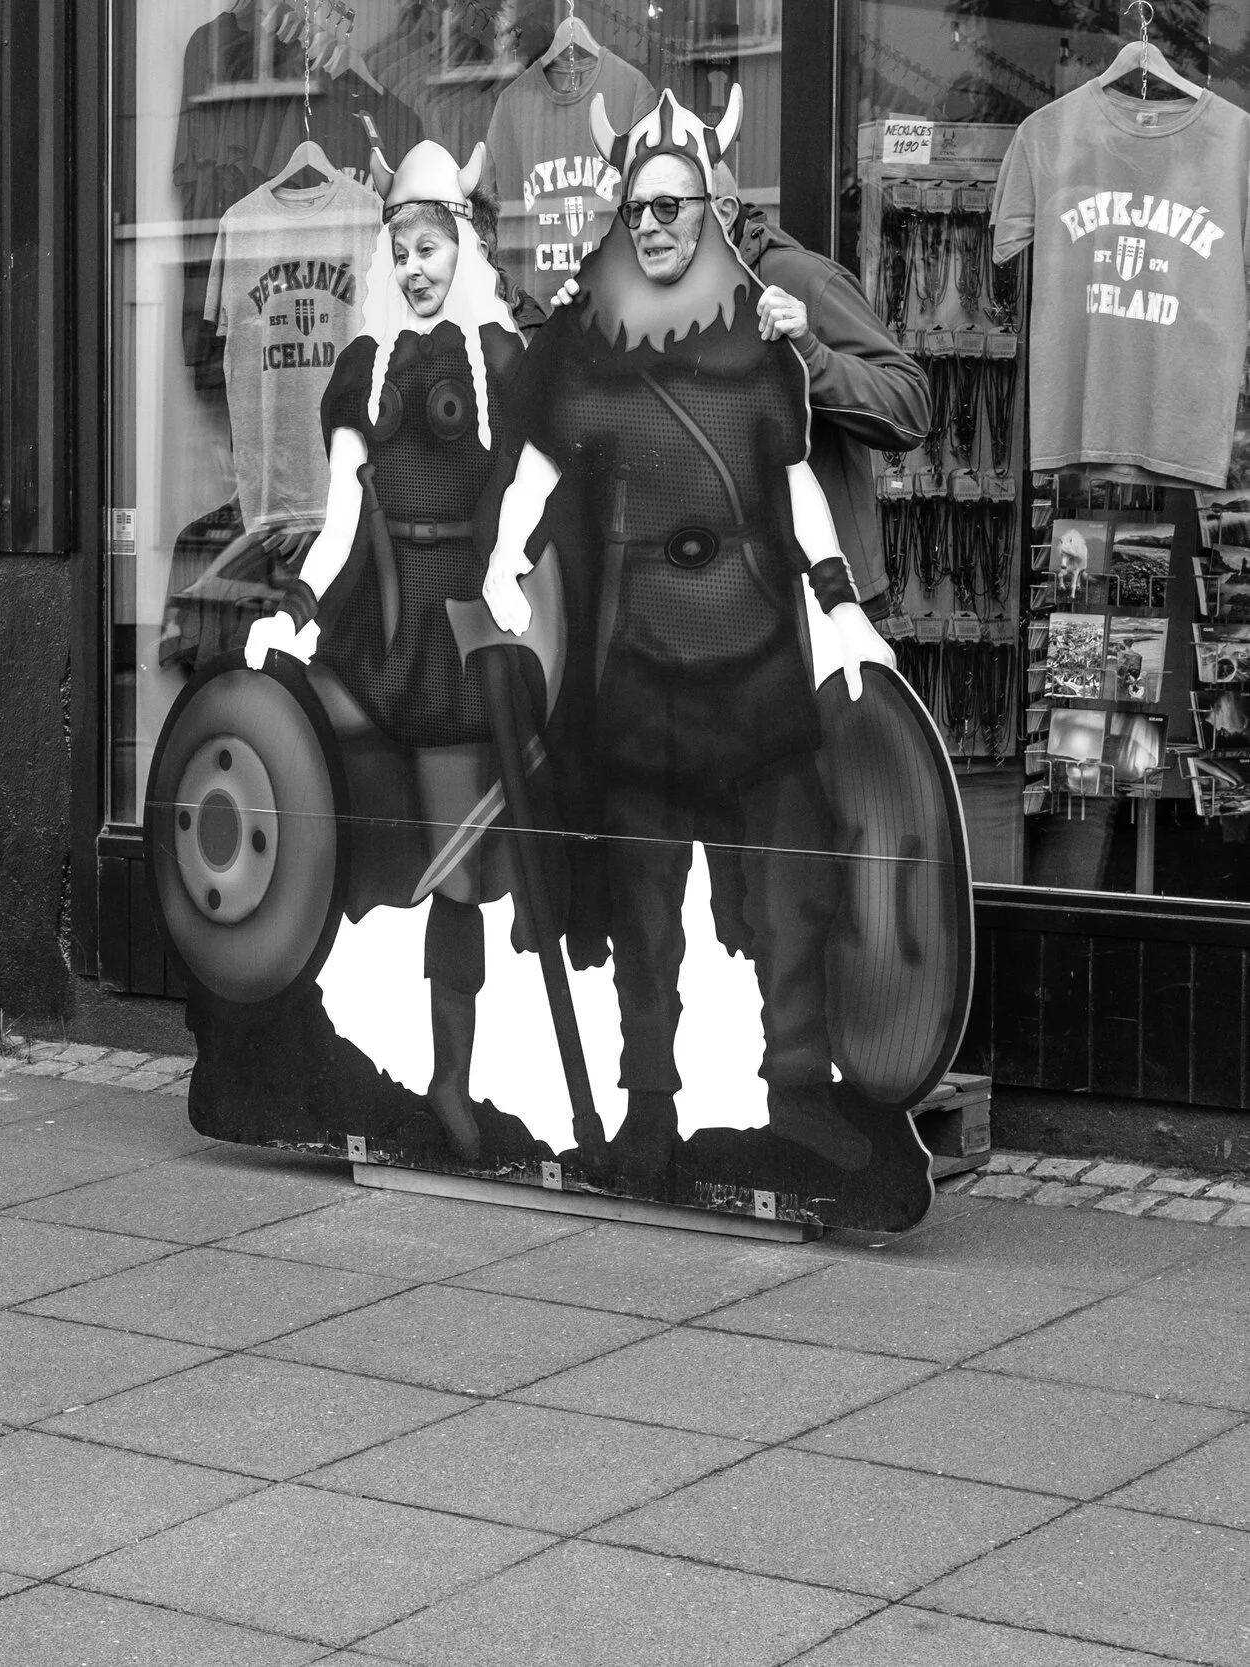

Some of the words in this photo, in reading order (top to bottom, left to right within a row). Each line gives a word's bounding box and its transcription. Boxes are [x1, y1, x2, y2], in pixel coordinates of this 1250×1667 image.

[885, 124, 933, 136] NECKLACES
[893, 140, 920, 154] 1190
[1060, 191, 1226, 260] REYKJAVÍK
[1149, 258, 1169, 273] 874
[1086, 283, 1180, 326] ICELAND
[269, 314, 289, 326] EST.
[262, 341, 336, 372] ICELAD
